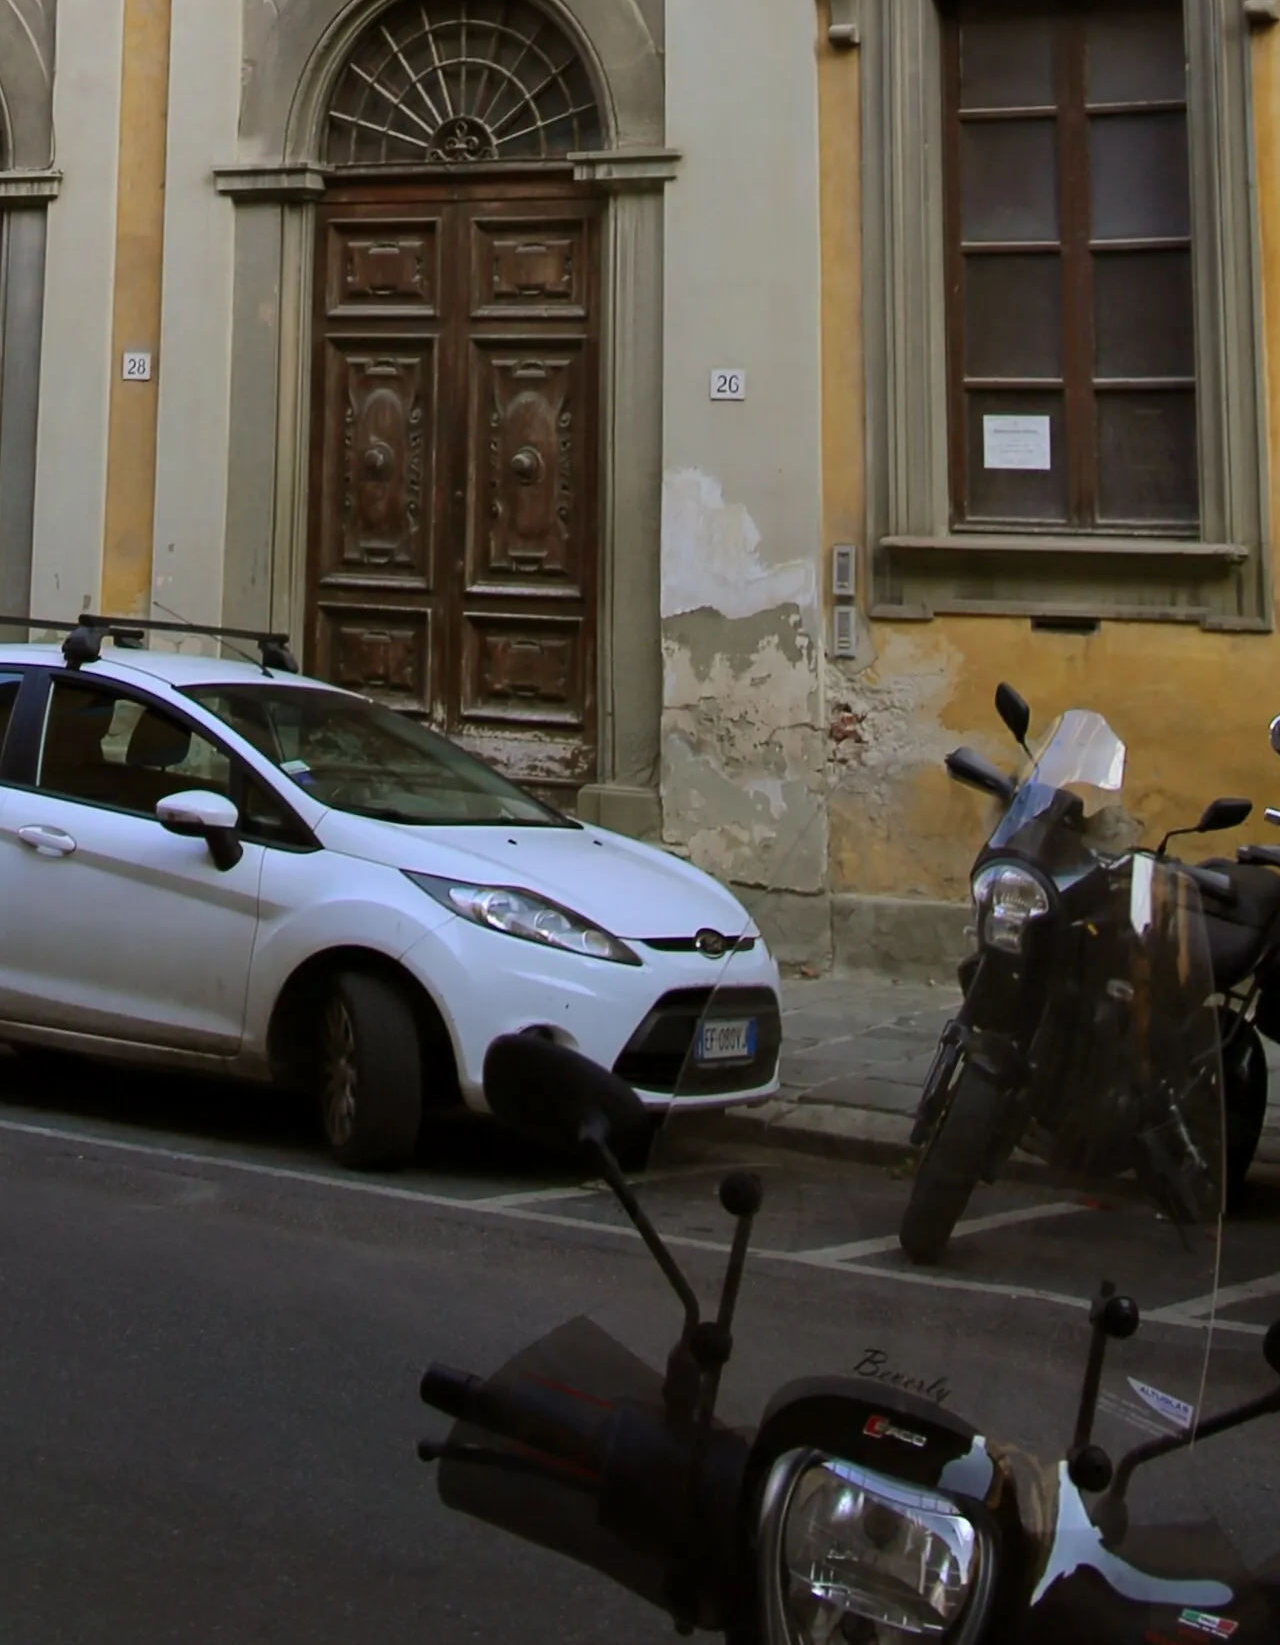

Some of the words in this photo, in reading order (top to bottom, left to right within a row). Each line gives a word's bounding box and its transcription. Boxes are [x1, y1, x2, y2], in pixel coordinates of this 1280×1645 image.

[127, 358, 146, 375] 28
[717, 374, 739, 394] 26
[853, 1348, 952, 1404] Beverly
